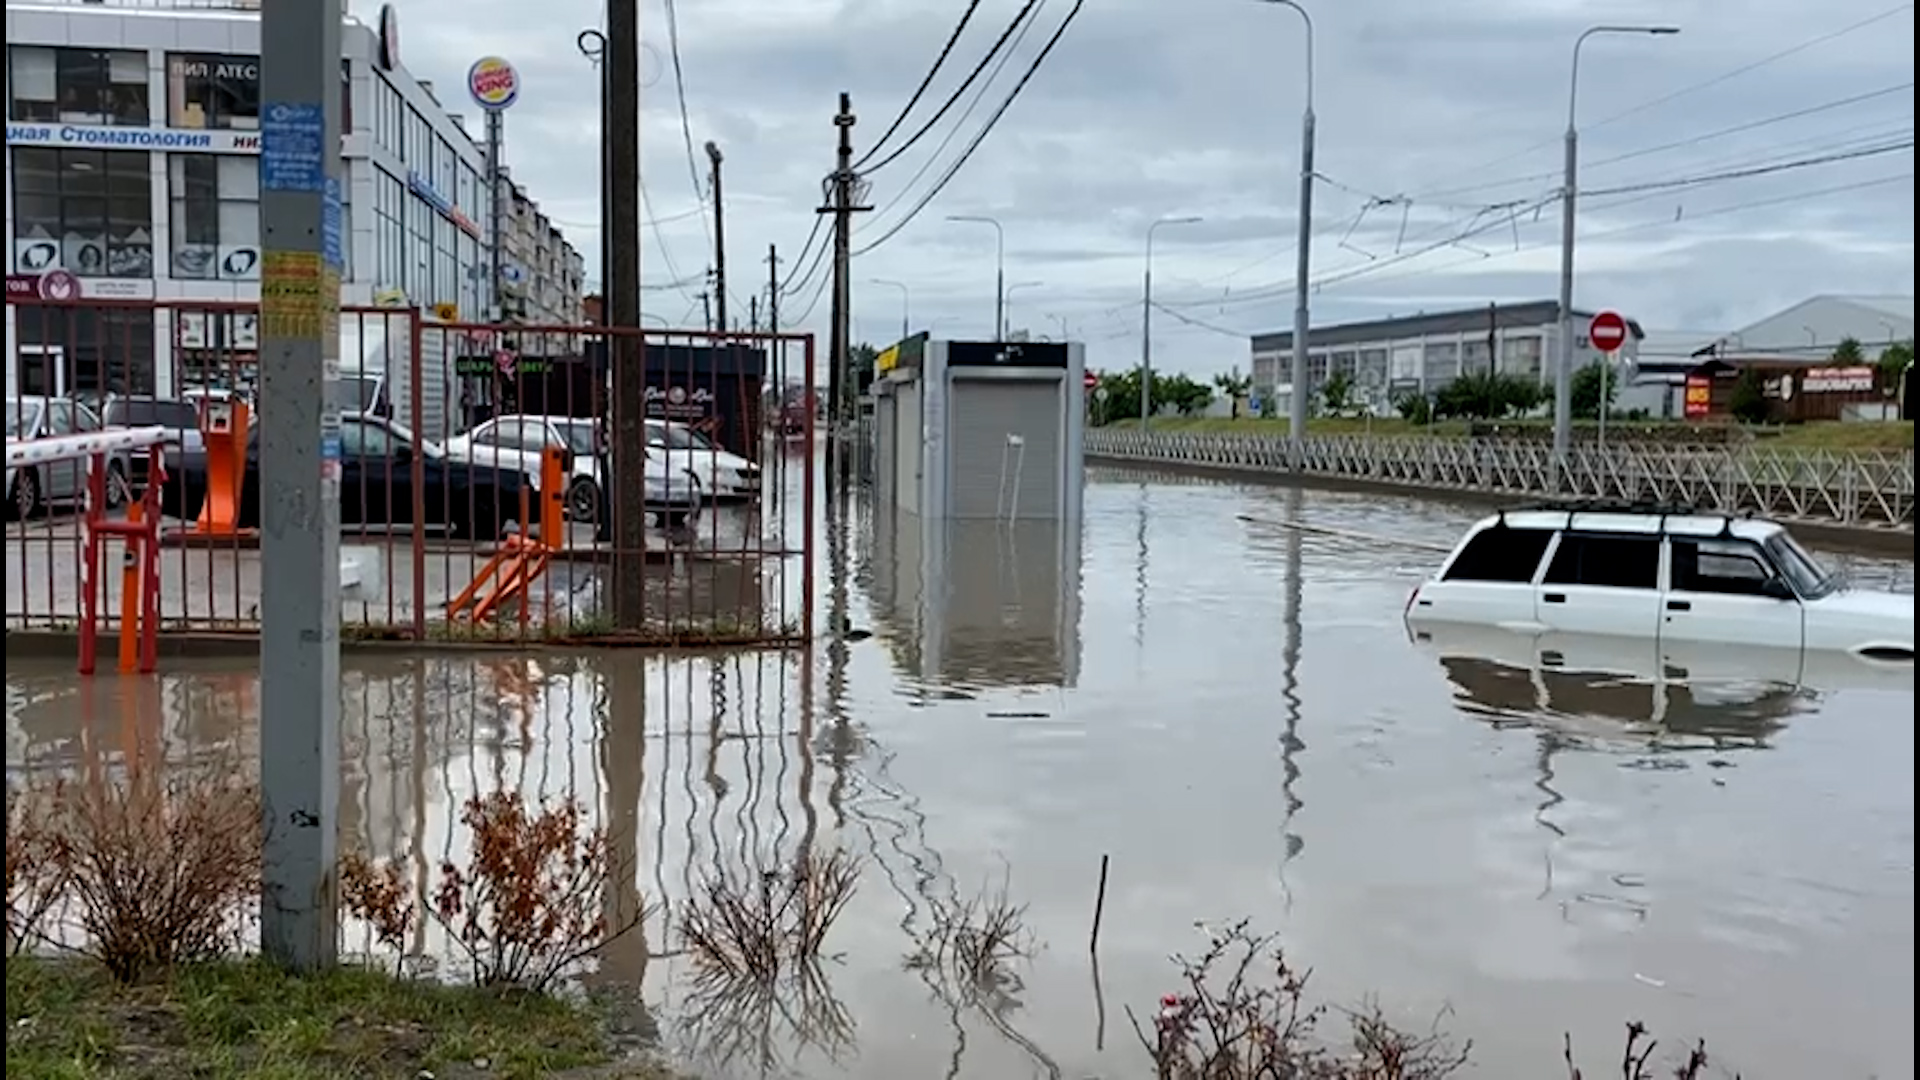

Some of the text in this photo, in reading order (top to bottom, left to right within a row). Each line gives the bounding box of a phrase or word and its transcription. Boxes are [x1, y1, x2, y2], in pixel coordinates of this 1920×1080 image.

[474, 66, 511, 82] BURGER
[476, 78, 513, 94] KING
[60, 126, 211, 147] Стоматология
